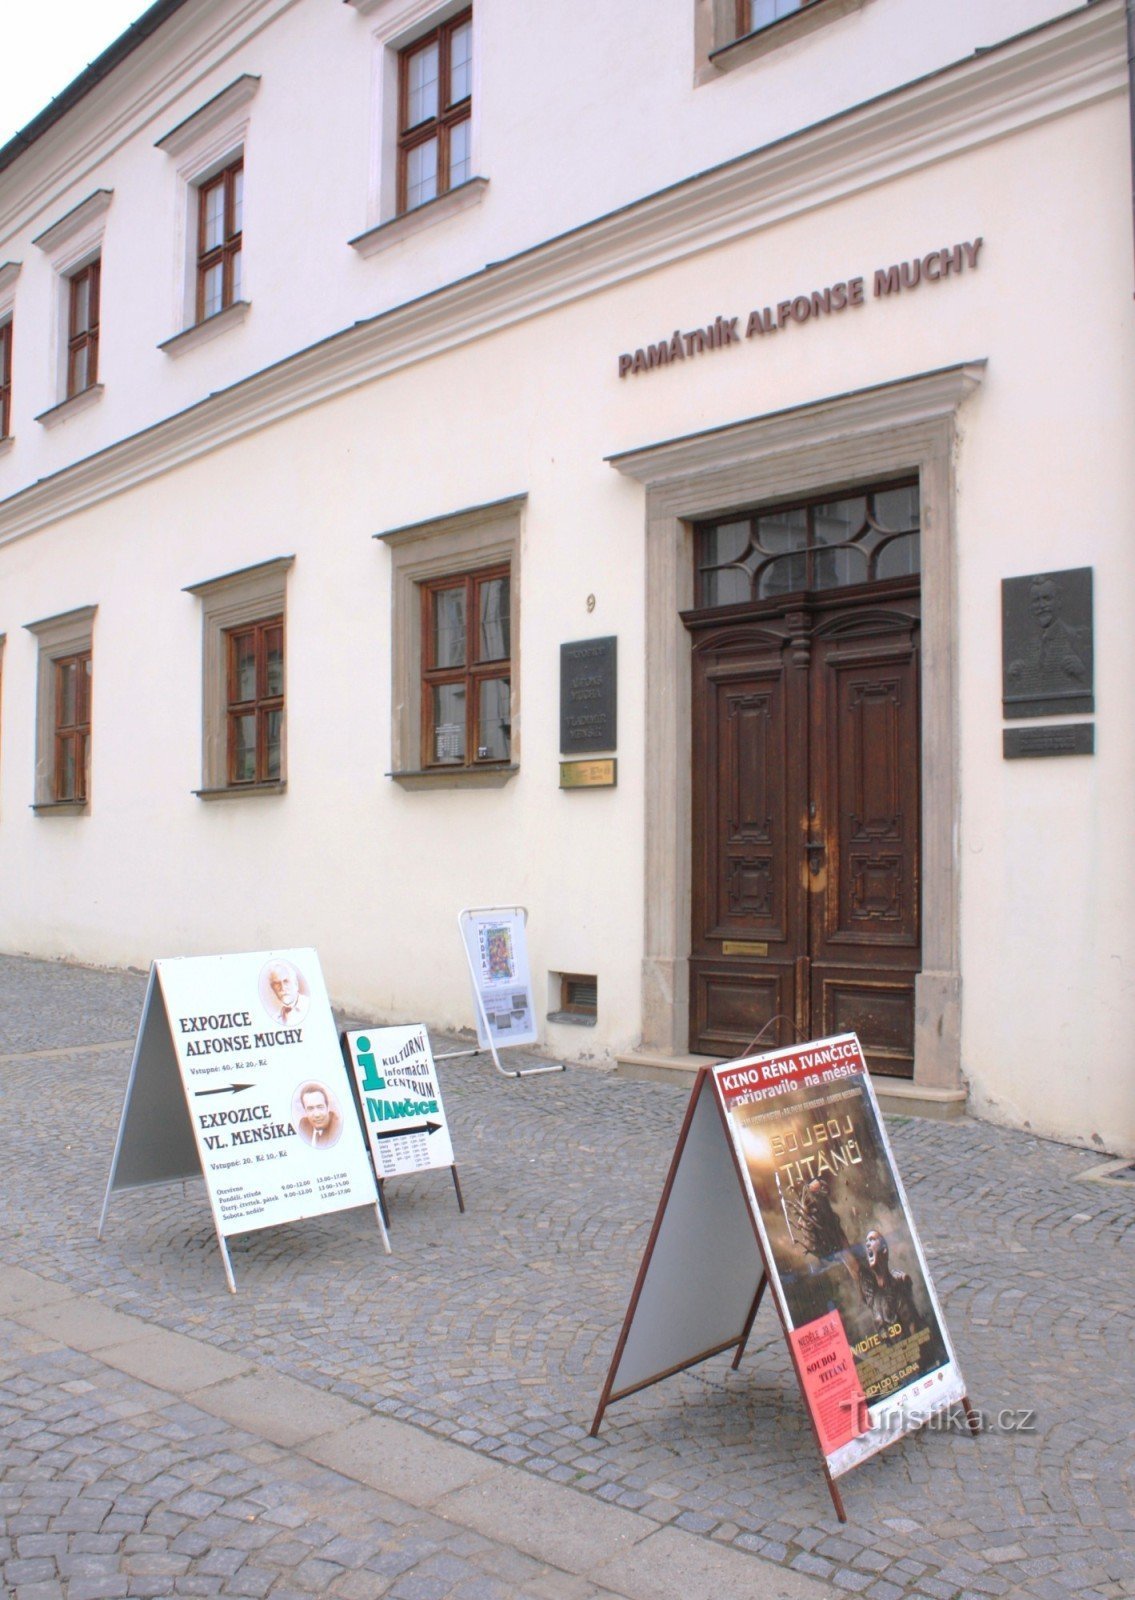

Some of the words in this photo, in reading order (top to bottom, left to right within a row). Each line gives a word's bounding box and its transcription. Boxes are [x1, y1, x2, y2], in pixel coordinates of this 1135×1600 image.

[618, 316, 740, 378] PAMÁTNÍK
[746, 276, 866, 339] ALFONSE
[873, 236, 984, 297] MUCHY
[586, 593, 596, 614] 9
[179, 1012, 252, 1033] EXPOZICE
[186, 1035, 252, 1056] ALFONSE
[254, 1029, 303, 1048] MUCHY
[382, 1031, 425, 1066] KULTURNÍ
[190, 1065, 221, 1075] Vstupné:
[235, 1060, 244, 1069] Kč
[258, 1058, 268, 1067] Kč
[722, 1069, 759, 1091] KINO
[761, 1058, 798, 1081] RÉNA
[798, 1042, 860, 1071] IVANČICE
[386, 1078, 435, 1098] CENTRUM
[735, 1078, 798, 1107] připravilo
[803, 1073, 821, 1088] na
[823, 1060, 857, 1082] měsíc
[199, 1104, 272, 1129] EXPOZICE
[366, 1097, 439, 1122] IVANČICE
[203, 1135, 229, 1150] VL.
[231, 1122, 297, 1146] MENŠÍKA
[771, 1115, 854, 1157] SOUBOJ
[210, 1159, 242, 1171] Vstupné:
[256, 1153, 265, 1162] Kč
[279, 1149, 288, 1158] Kč
[779, 1139, 863, 1188] TITÁNŮ
[888, 1322, 902, 1338] 3D
[806, 1351, 837, 1375] SOUBOJ
[818, 1358, 848, 1383] TITÁNŮ
